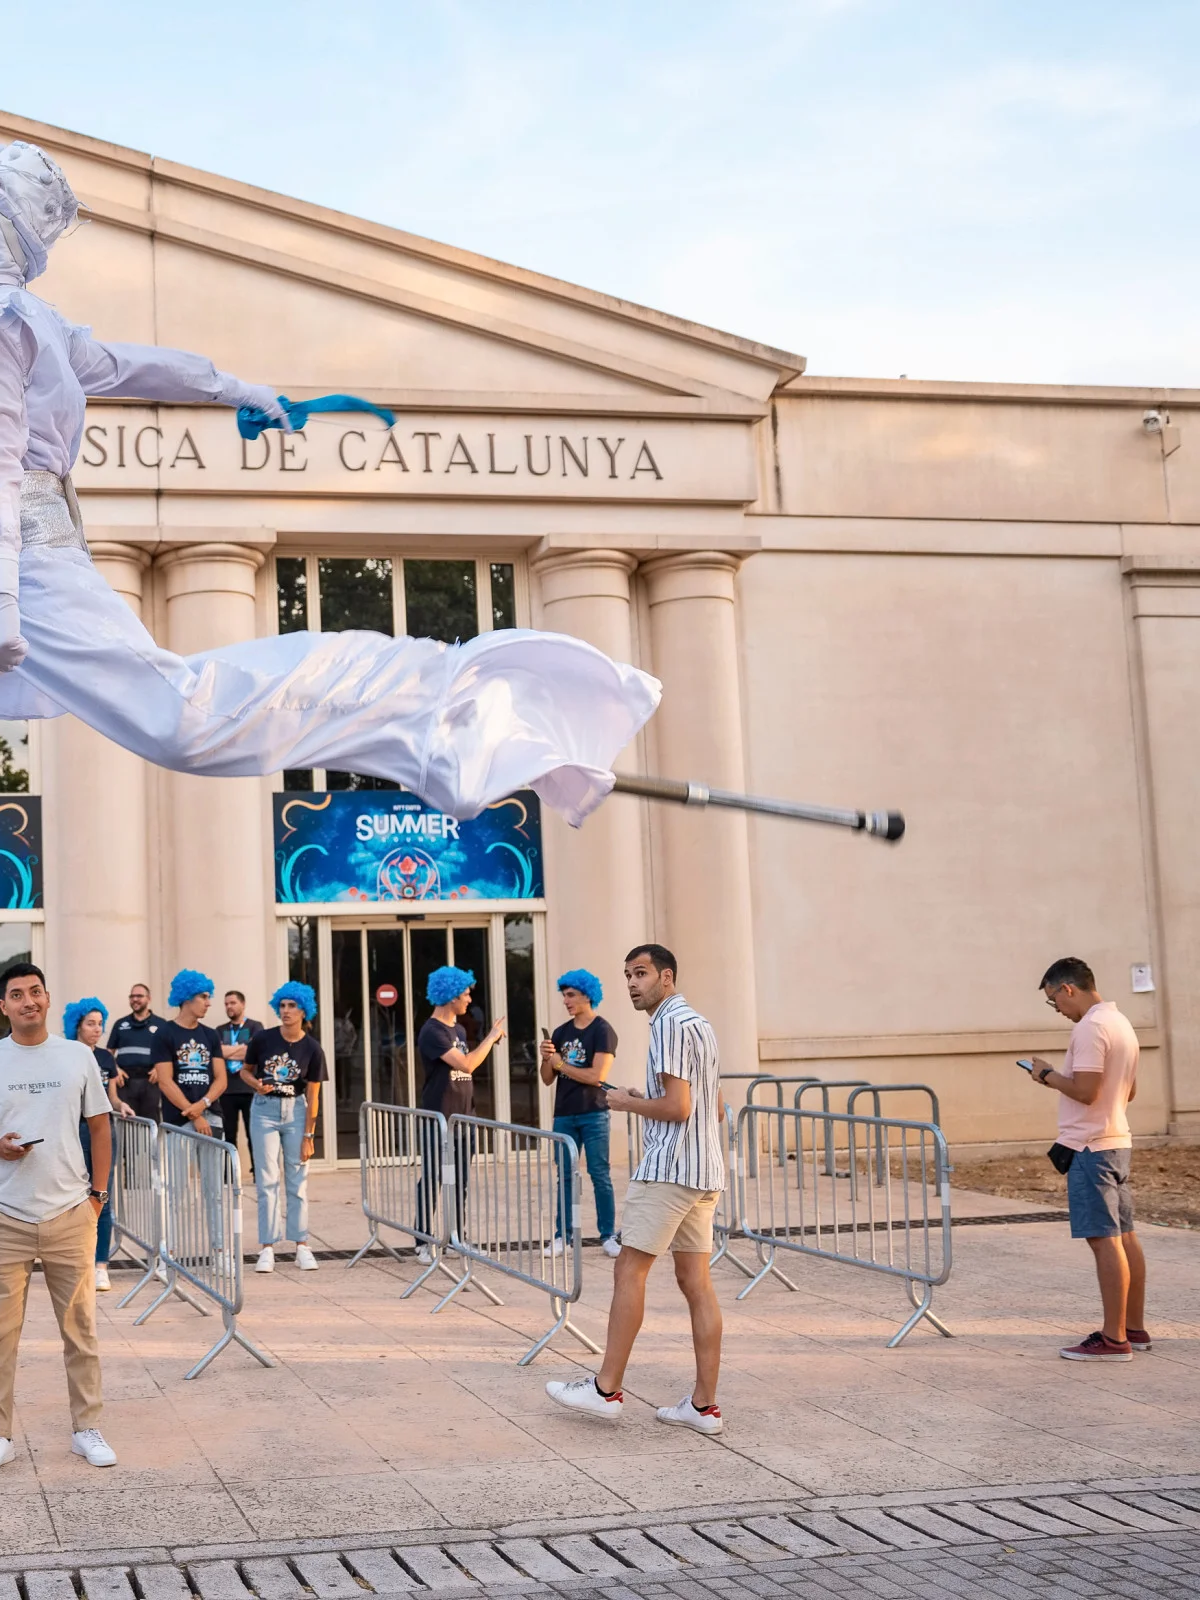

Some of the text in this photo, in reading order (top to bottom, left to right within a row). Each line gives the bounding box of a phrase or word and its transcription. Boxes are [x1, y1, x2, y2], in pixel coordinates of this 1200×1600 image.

[82, 424, 206, 470] SICA
[241, 429, 308, 472] DE
[339, 430, 664, 480] CATALUNYA
[356, 814, 460, 841] SUMMER
